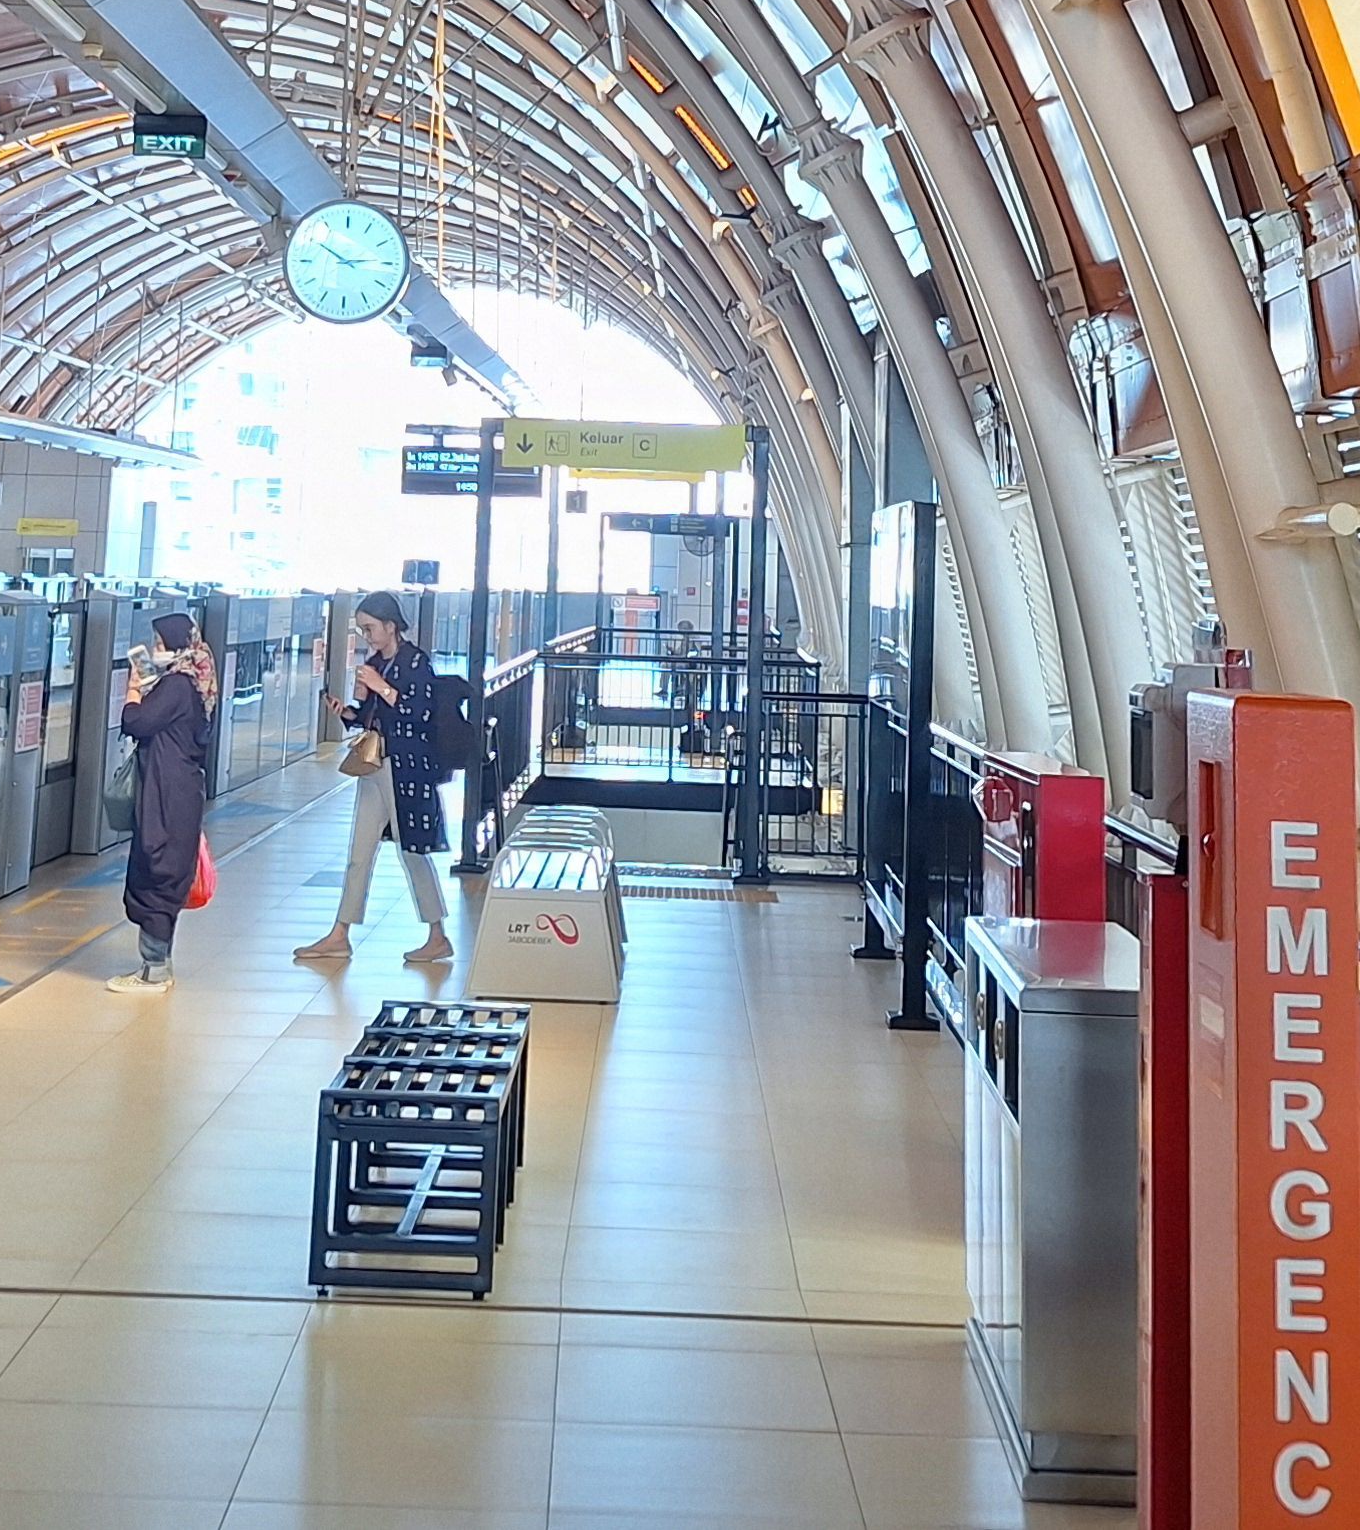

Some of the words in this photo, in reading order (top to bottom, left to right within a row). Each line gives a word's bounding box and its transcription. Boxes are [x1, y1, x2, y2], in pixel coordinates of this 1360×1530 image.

[141, 134, 197, 152] EXIT
[580, 431, 624, 444] Keluar
[639, 439, 651, 452] C
[580, 447, 598, 457] Exit
[508, 923, 530, 933] LRT
